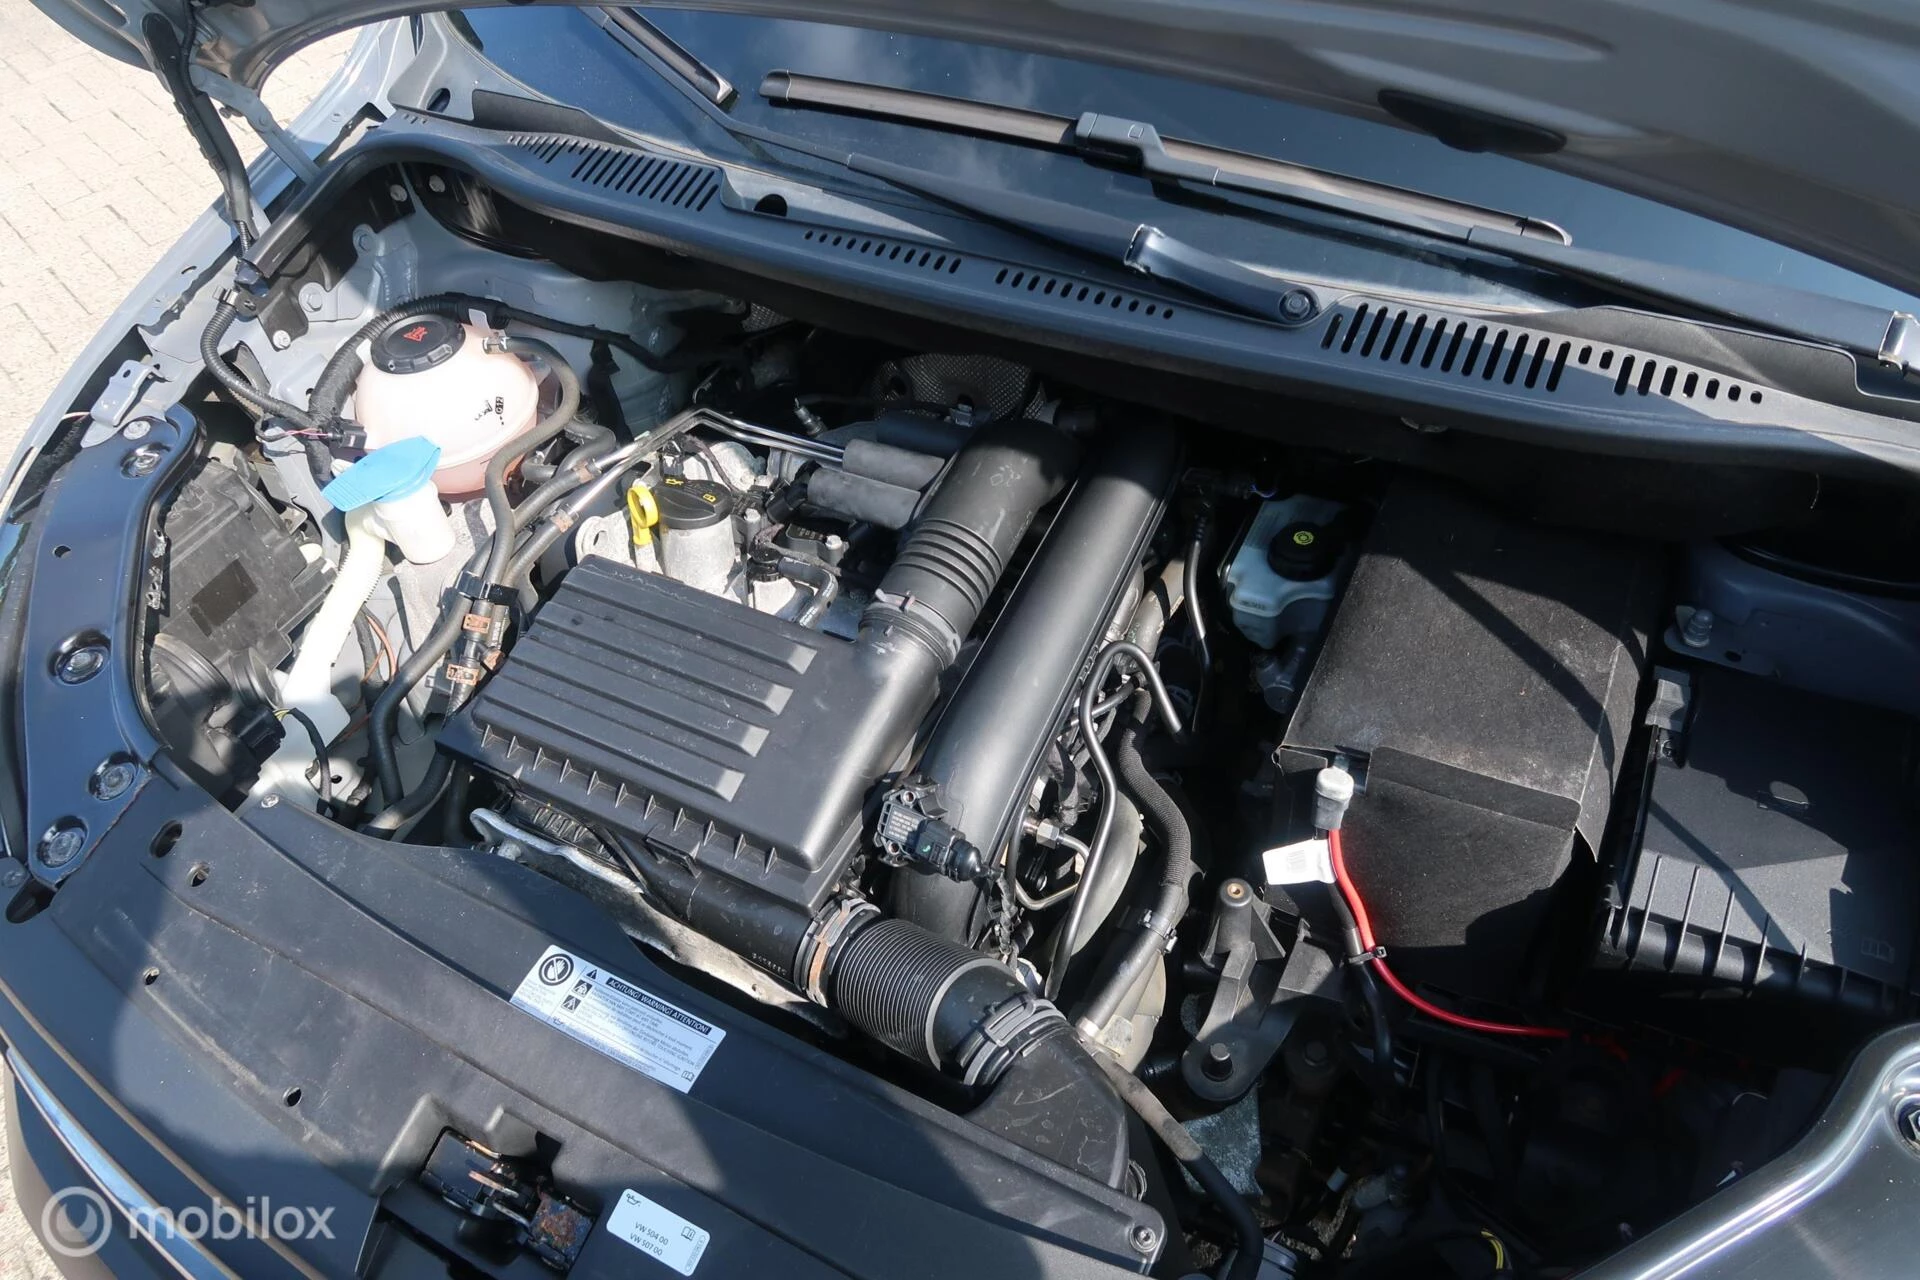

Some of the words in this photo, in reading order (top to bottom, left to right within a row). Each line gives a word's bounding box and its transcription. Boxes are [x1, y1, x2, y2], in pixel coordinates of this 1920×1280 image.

[608, 979, 641, 1000] ACHTUNG!
[640, 995, 673, 1016] WARNING!
[671, 1010, 710, 1034] ATTENTION!
[629, 1233, 642, 1243] VW
[641, 1240, 654, 1251] 507
[652, 1246, 663, 1256] 00
[634, 1222, 647, 1233] VW
[646, 1229, 659, 1240] 504
[658, 1236, 669, 1246] 00
